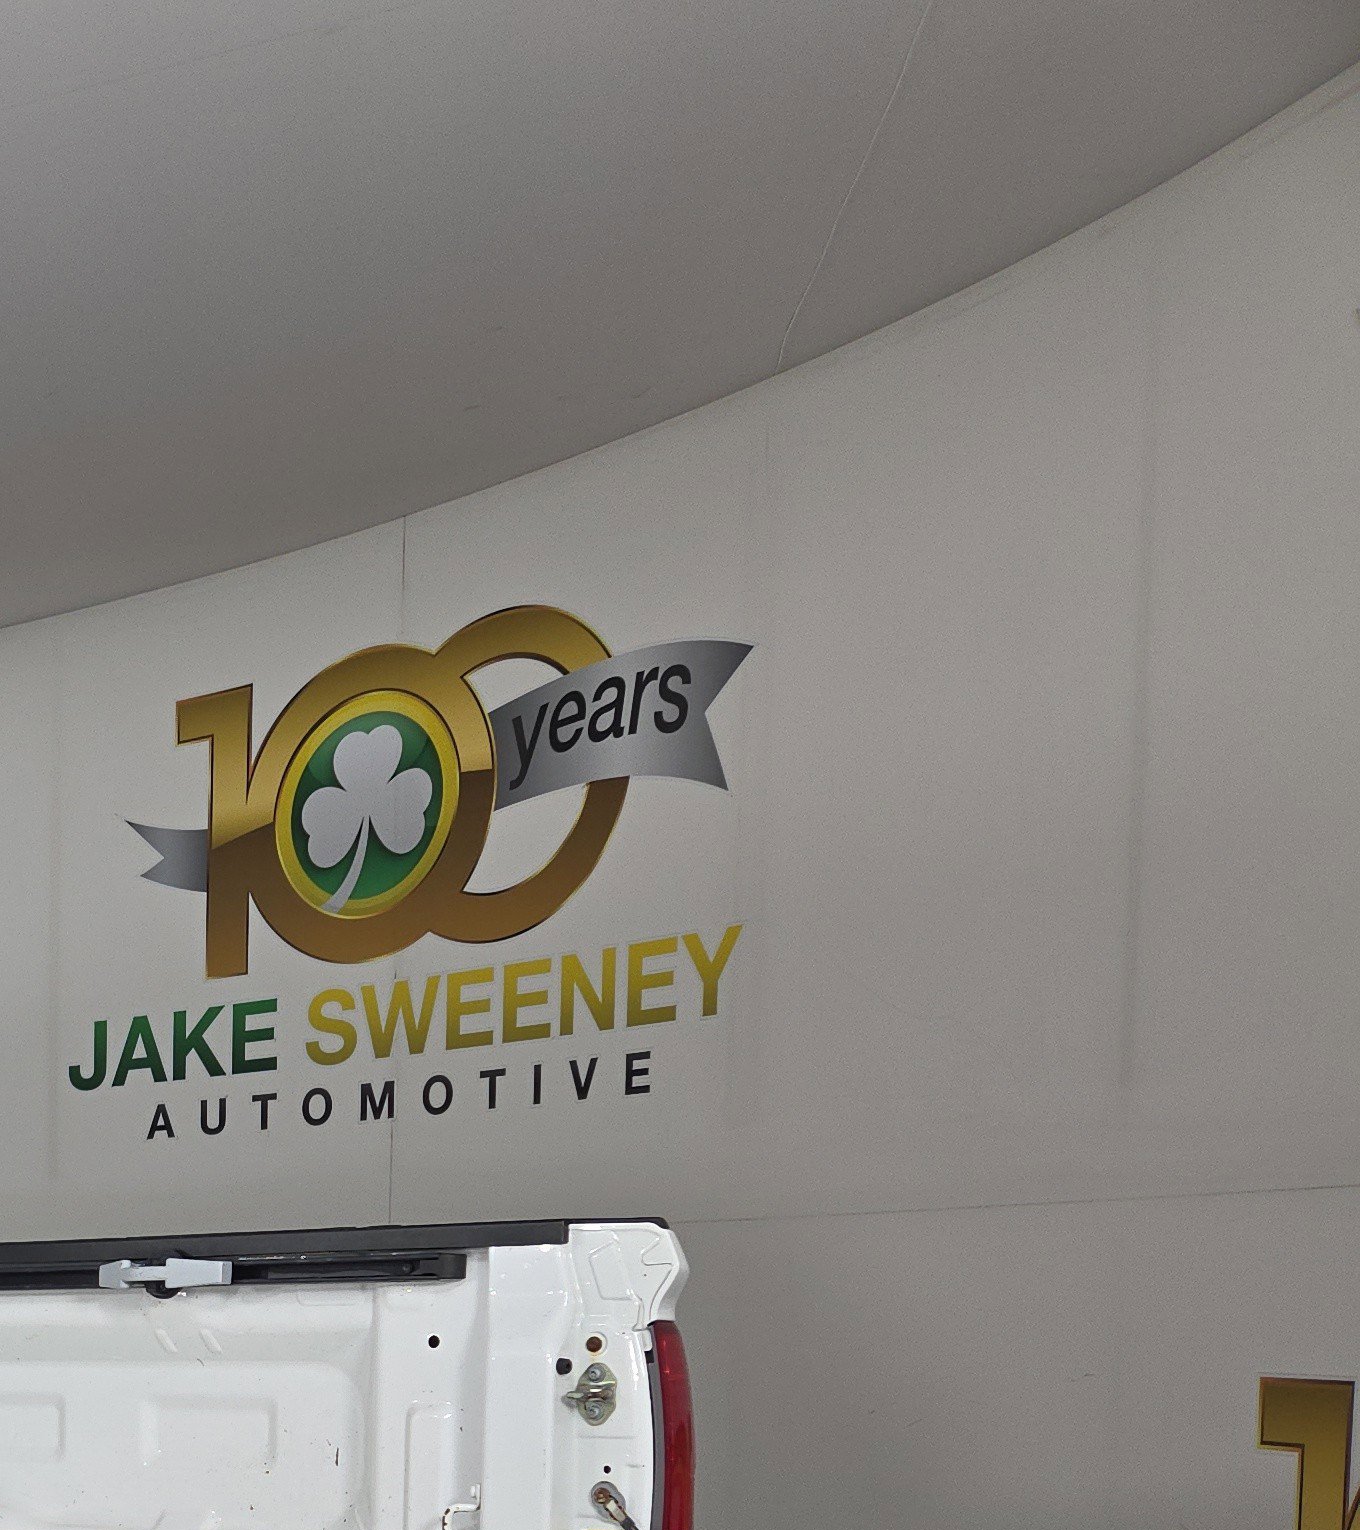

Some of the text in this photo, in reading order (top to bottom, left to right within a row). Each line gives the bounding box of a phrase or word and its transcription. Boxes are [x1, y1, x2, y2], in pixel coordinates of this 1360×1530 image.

[176, 604, 632, 979] 100
[509, 662, 692, 790] years
[68, 923, 744, 1091] JAKE SWEENEY
[146, 1050, 653, 1141] AUTOMOTIVE
